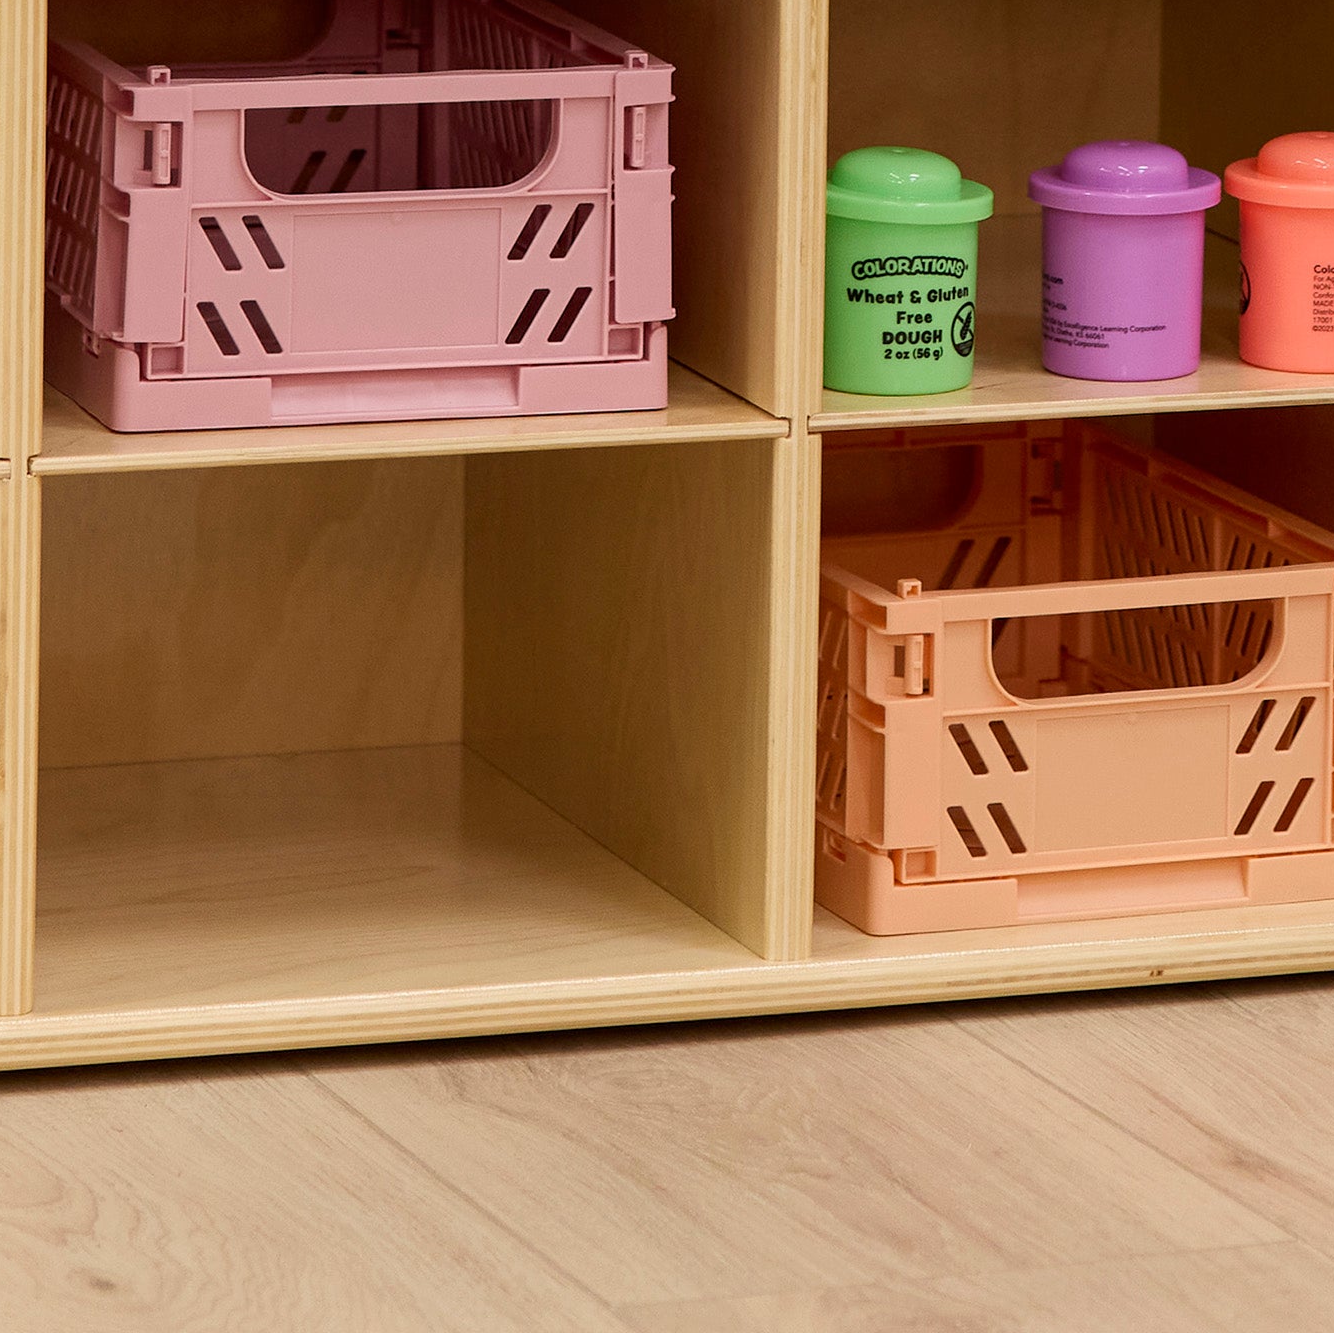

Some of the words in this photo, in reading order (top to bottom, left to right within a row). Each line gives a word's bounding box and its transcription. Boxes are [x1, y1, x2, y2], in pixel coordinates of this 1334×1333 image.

[851, 255, 966, 281] COLORATIONS
[847, 287, 904, 304] Wheat
[909, 290, 921, 304] &
[927, 286, 969, 303] Gluten
[896, 311, 933, 325] Free
[1100, 325, 1128, 334] Learning
[1129, 324, 1166, 333] Corporation
[882, 329, 943, 345] DOUGH
[884, 348, 893, 360] 2
[895, 350, 910, 360] oz
[912, 347, 931, 360] (56
[932, 346, 944, 361] g)
